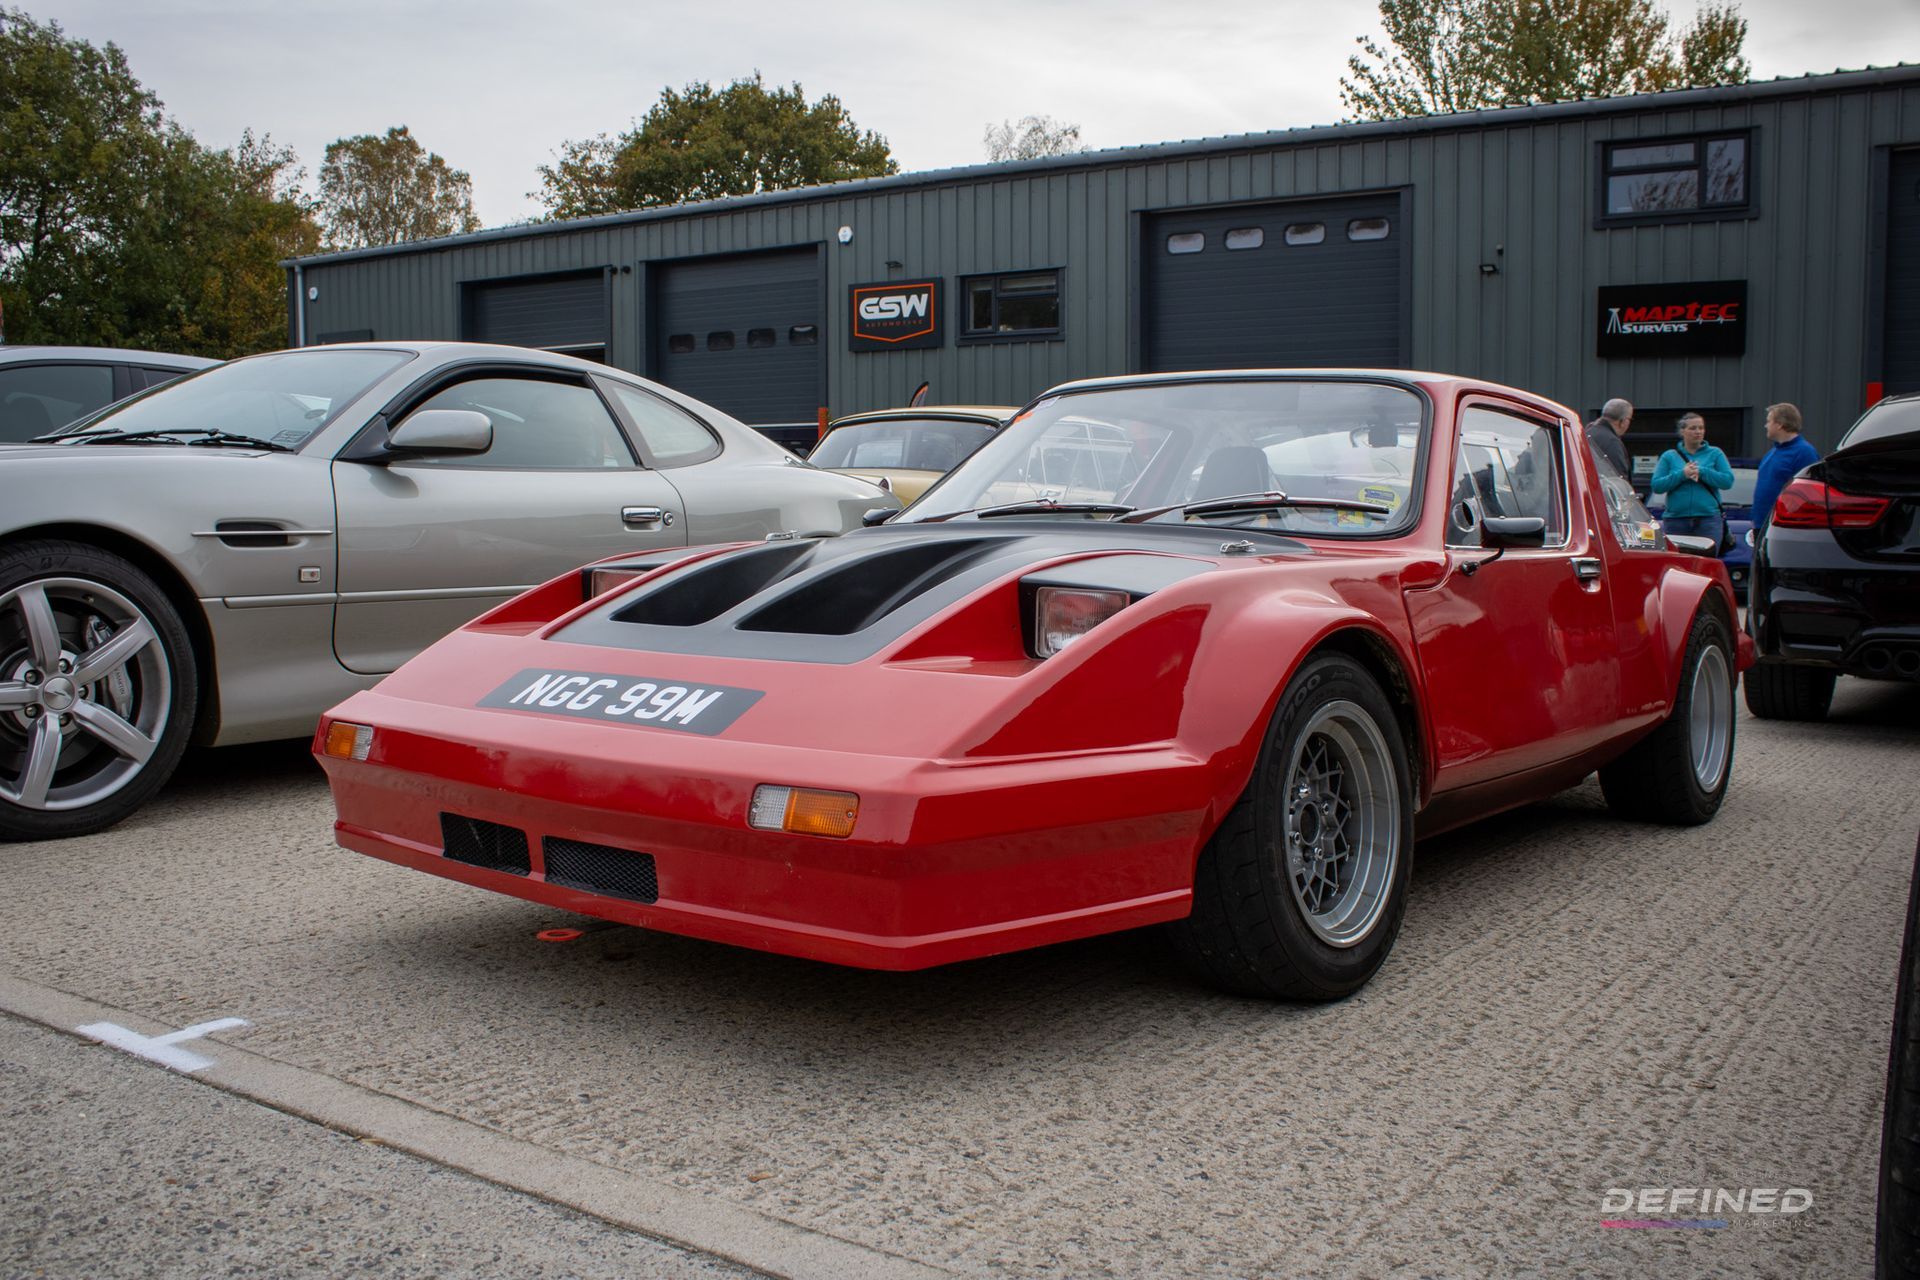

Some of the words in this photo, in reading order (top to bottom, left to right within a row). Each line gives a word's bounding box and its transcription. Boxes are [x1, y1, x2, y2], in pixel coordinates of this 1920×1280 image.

[859, 293, 928, 320] GSW
[1621, 323, 1689, 334] SURVEYS
[508, 673, 618, 711] NGG
[604, 682, 724, 726] 99M
